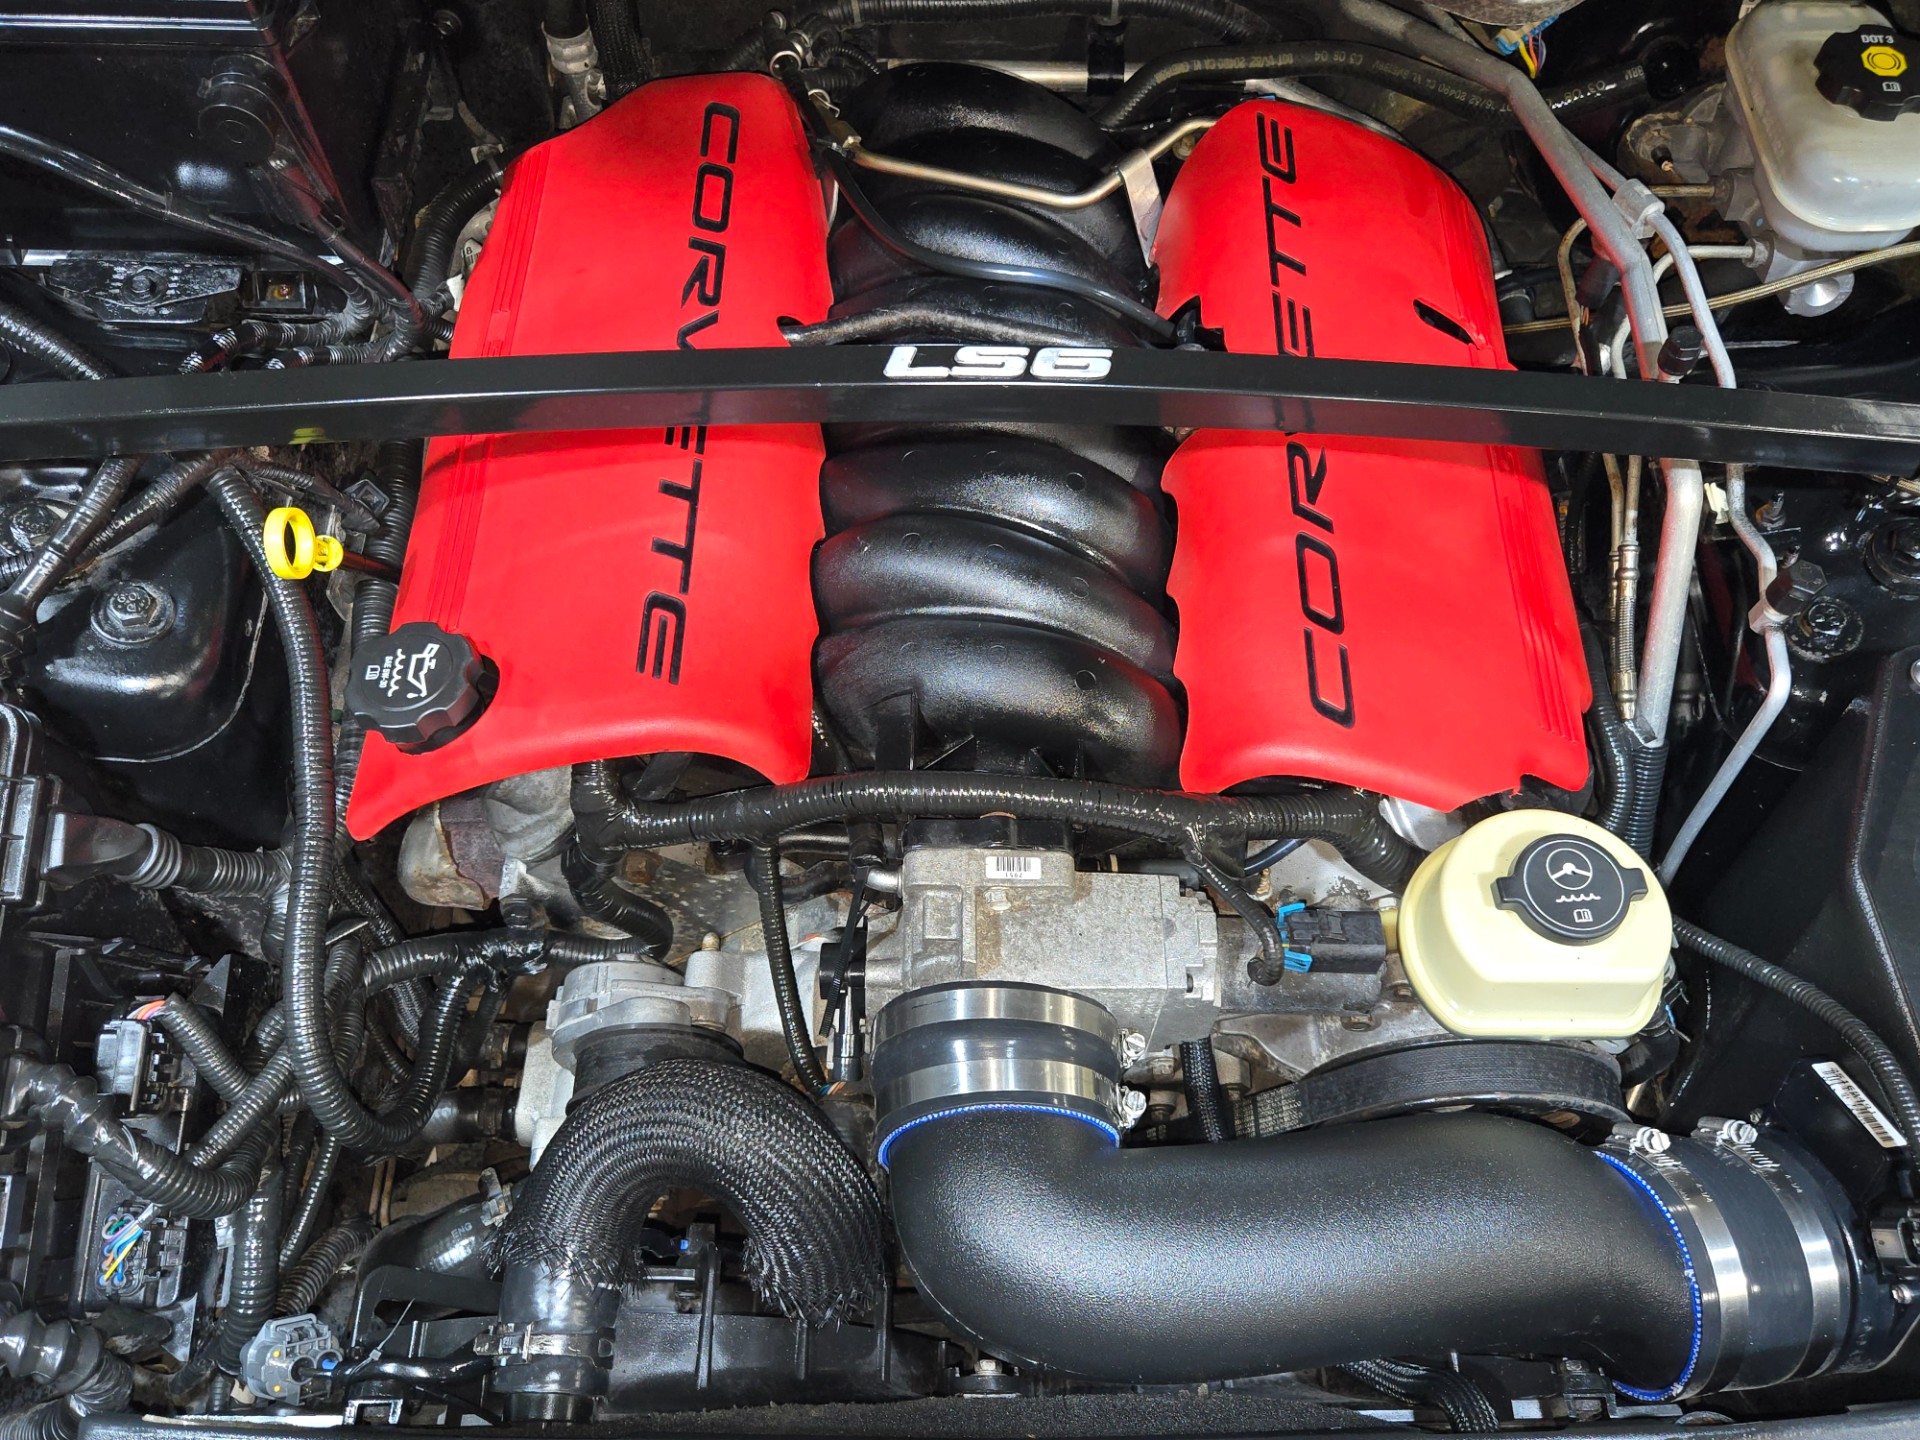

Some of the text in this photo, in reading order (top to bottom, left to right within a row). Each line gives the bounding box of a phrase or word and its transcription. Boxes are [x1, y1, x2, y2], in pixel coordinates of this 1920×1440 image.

[1861, 34, 1894, 43] DOT 3
[883, 346, 1114, 381] LS6
[1256, 112, 1355, 730] CORETTE
[379, 655, 393, 688] SAE 5W-30
[451, 1222, 473, 1241] ENG
